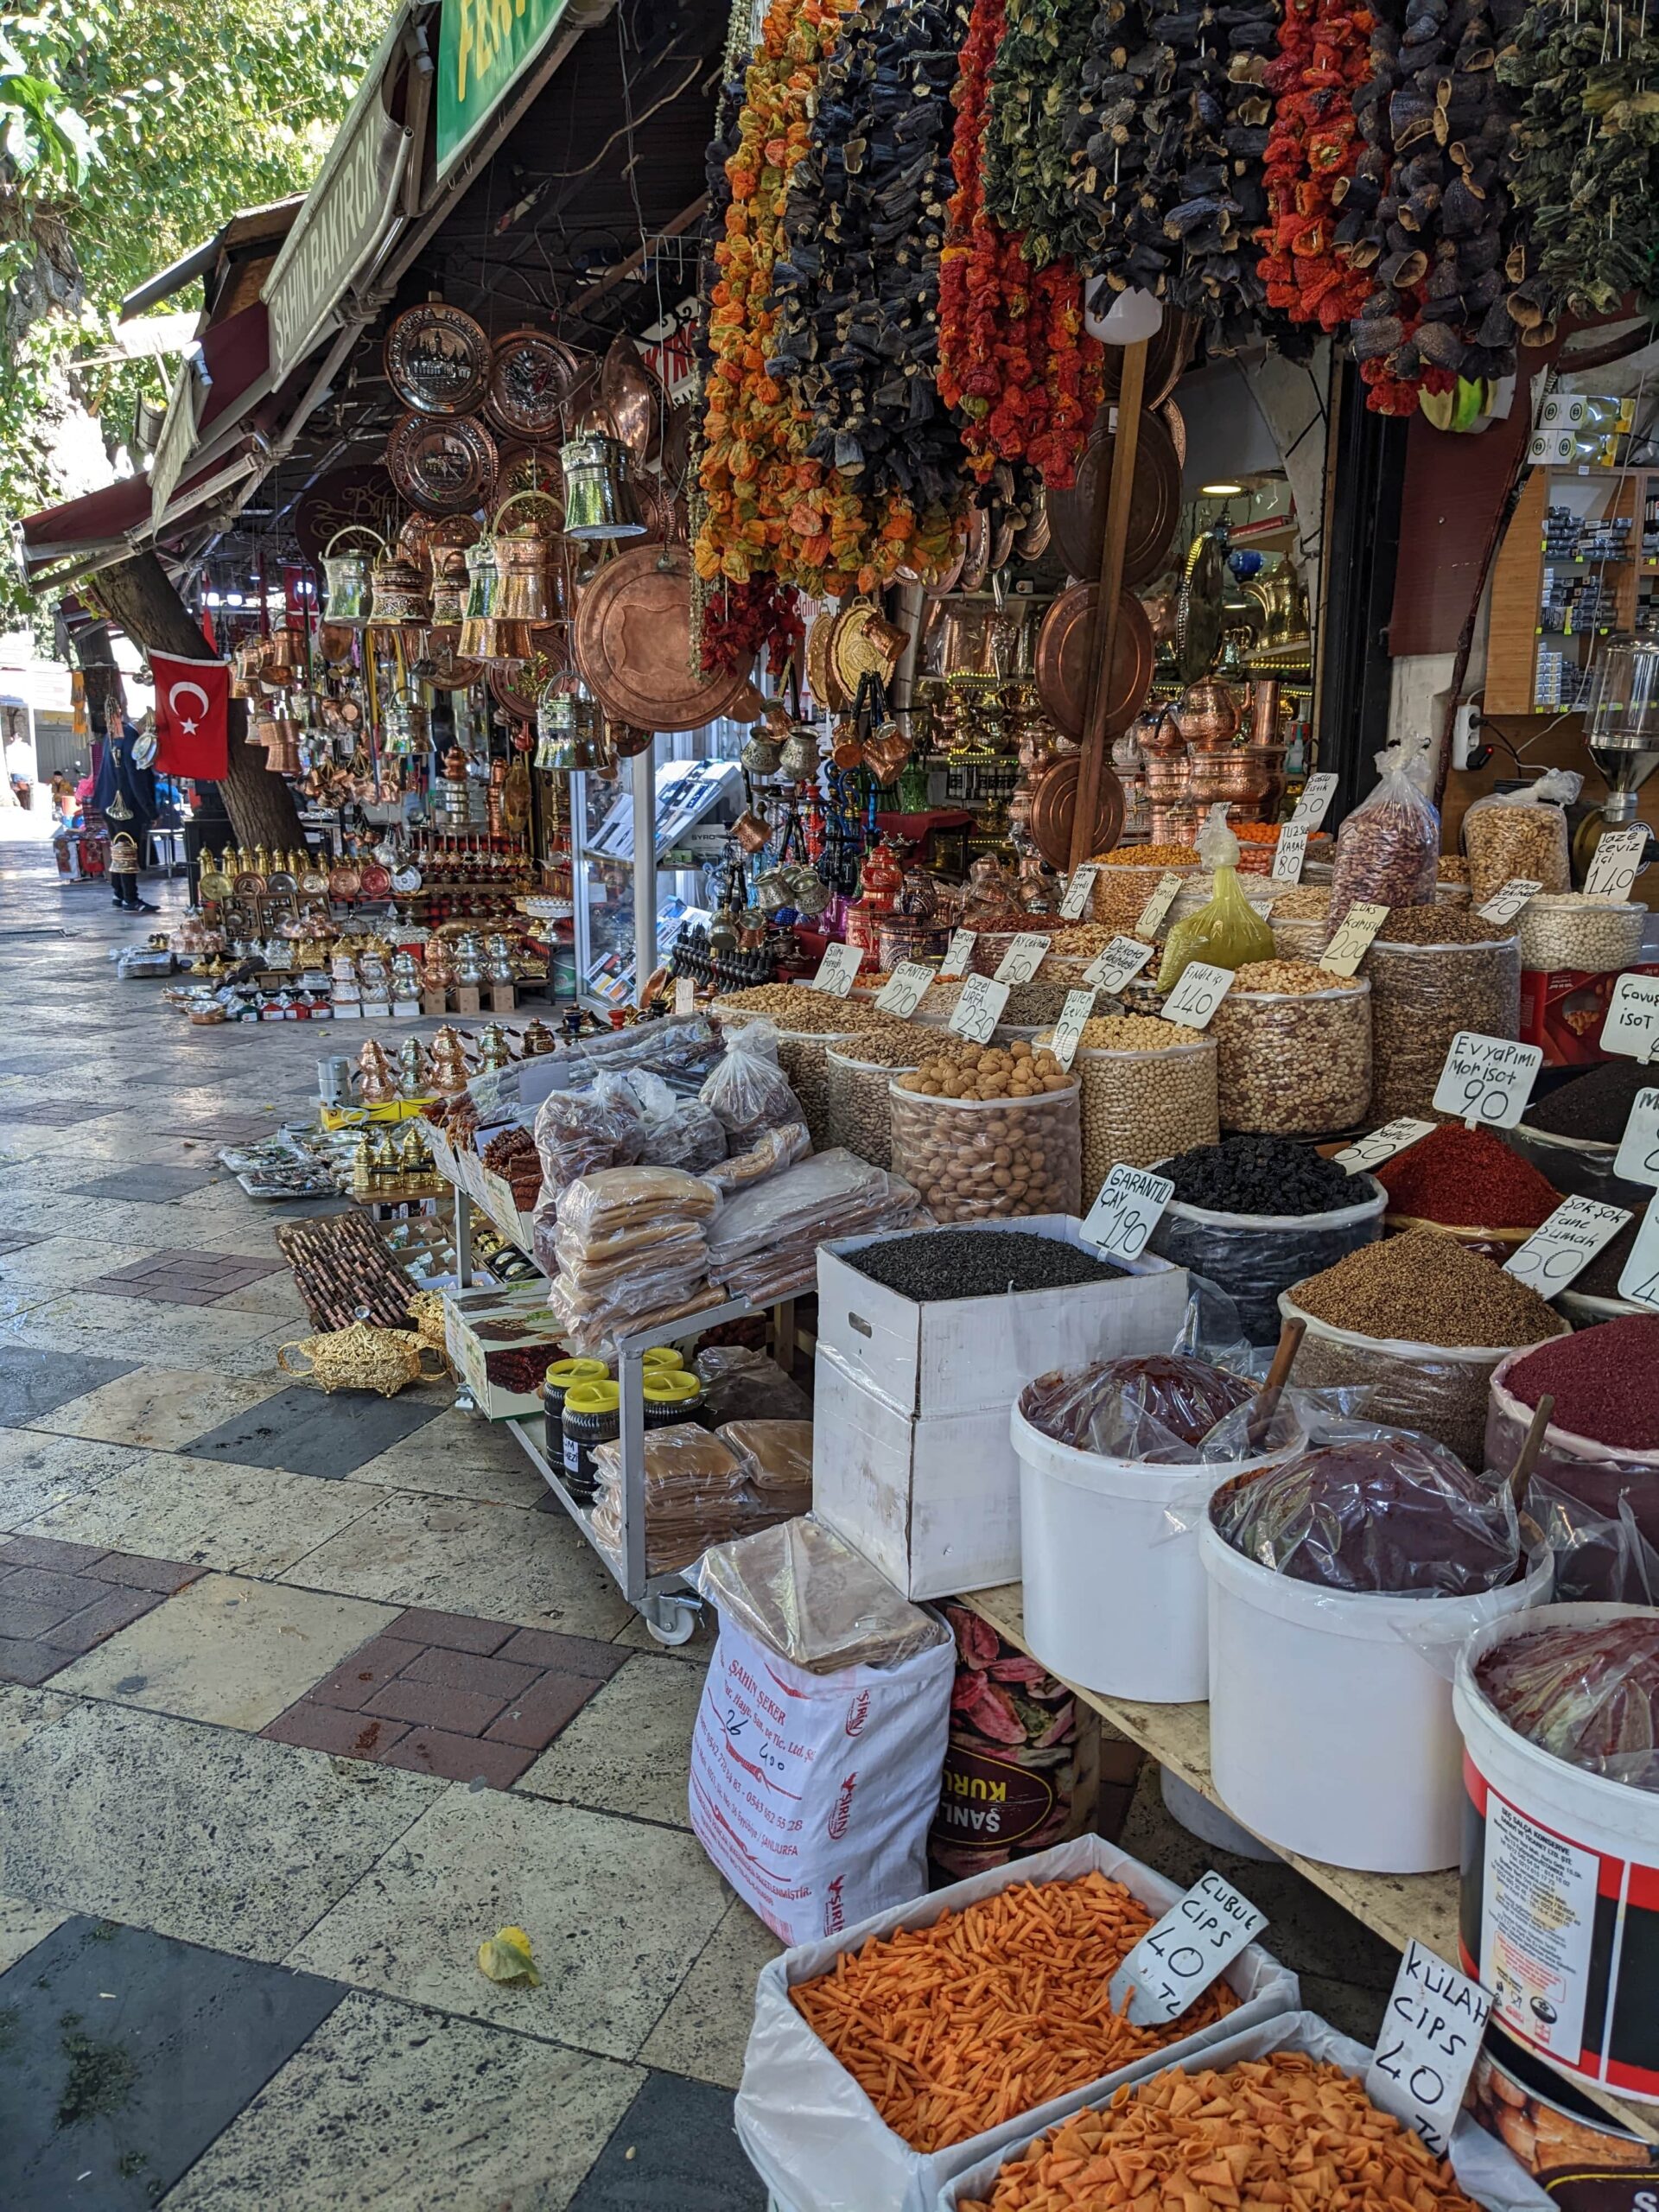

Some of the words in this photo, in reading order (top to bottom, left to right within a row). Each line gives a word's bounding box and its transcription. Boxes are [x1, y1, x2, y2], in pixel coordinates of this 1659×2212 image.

[1294, 793, 1325, 818] 50
[1277, 856, 1300, 876] 80
[1586, 867, 1635, 897] 140
[1060, 890, 1085, 914] 70
[1138, 898, 1164, 928] 100
[1479, 897, 1522, 917] 70
[944, 942, 969, 965] 50
[1324, 930, 1369, 960] 200
[818, 968, 853, 995] 220
[1001, 954, 1032, 982] 50
[1090, 963, 1124, 988] 50
[879, 983, 918, 1015] 220
[1172, 983, 1214, 1015] 140
[956, 1004, 995, 1039] 230
[1459, 1079, 1509, 1121] 90
[1331, 1139, 1397, 1161] 50
[1100, 1188, 1129, 1210] ÇAY
[1096, 1206, 1147, 1253] 190
[1505, 1237, 1584, 1279] 50
[728, 1659, 758, 1697] ŞAHİN
[756, 1691, 786, 1726] ŞEKER
[1147, 1927, 1204, 1978] 40
[1158, 1981, 1181, 2016] TL
[1406, 1941, 1491, 2028] KÜLAH
[1376, 2040, 1444, 2105] 40
